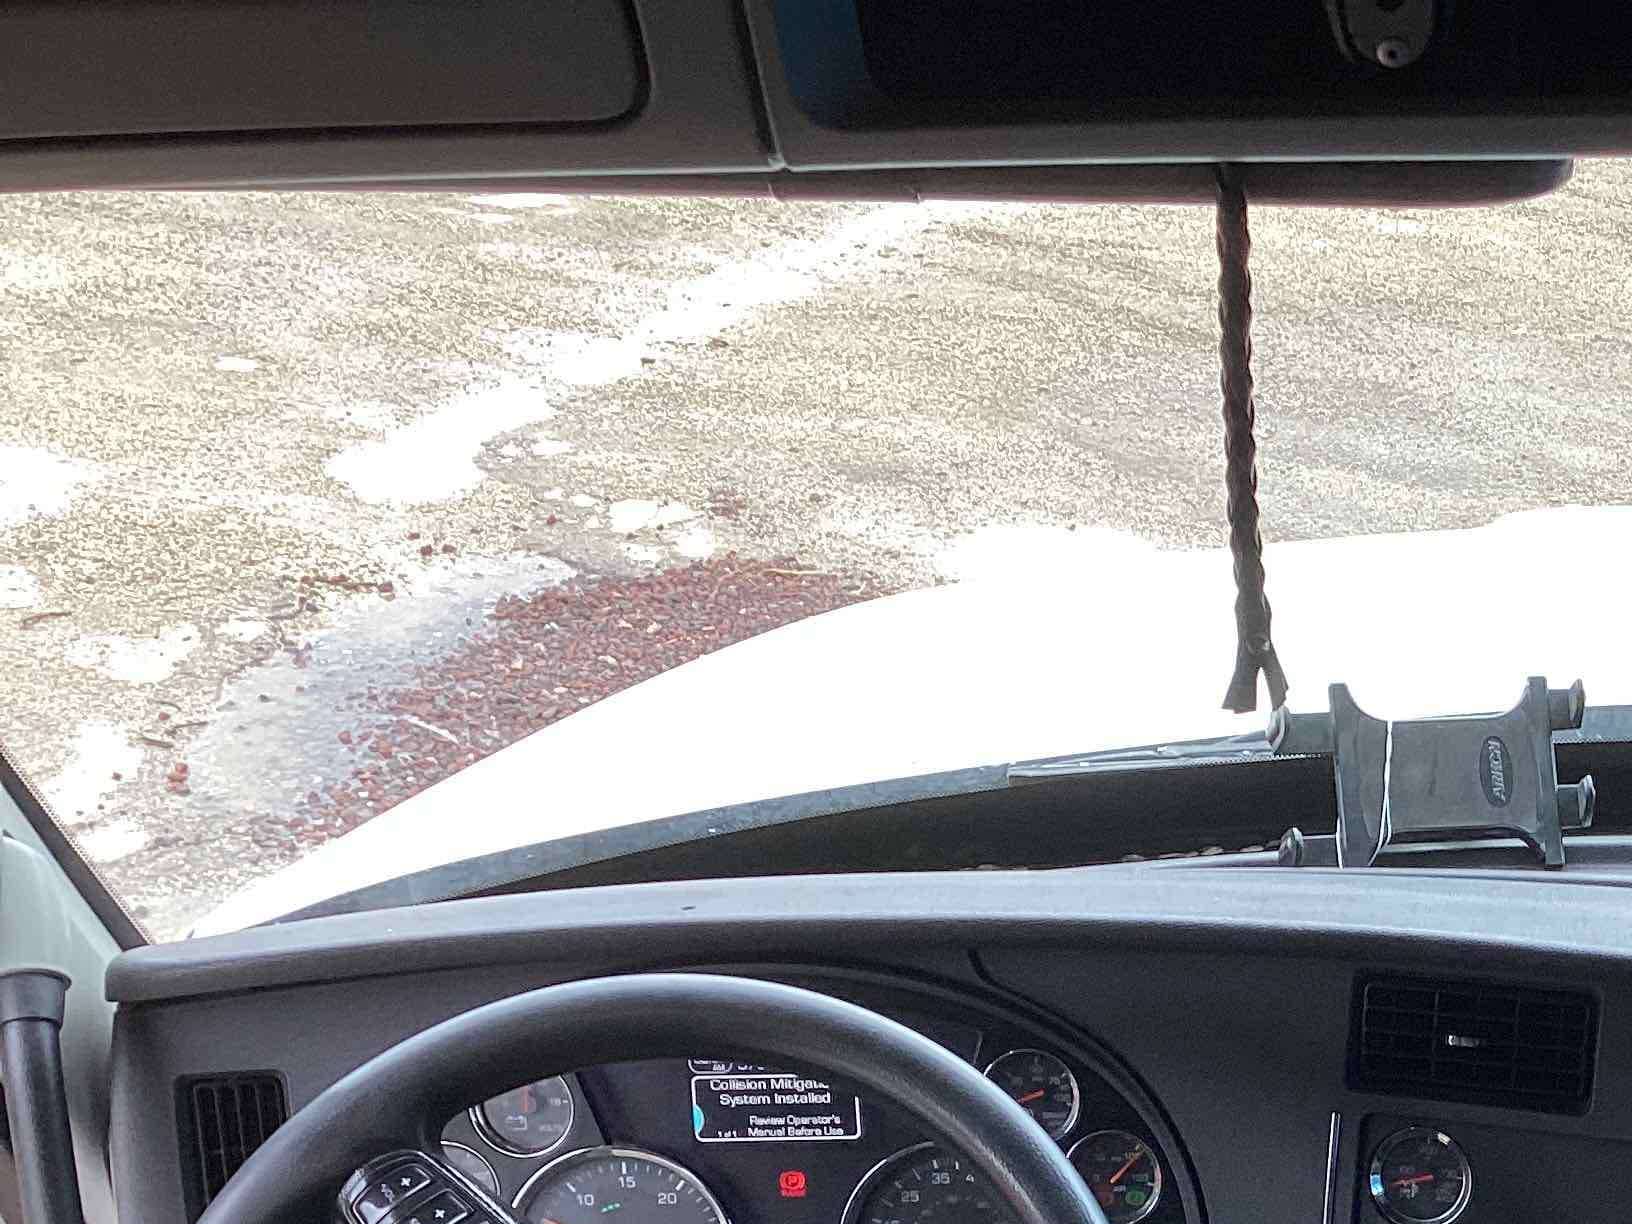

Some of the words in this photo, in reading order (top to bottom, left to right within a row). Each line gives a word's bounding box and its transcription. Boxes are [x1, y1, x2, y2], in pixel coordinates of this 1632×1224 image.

[710, 1079, 767, 1090] Collision
[719, 1093, 771, 1107] System
[774, 1092, 831, 1104] Installed
[749, 1116, 785, 1124] Review
[786, 1115, 841, 1126] Operator's
[747, 1127, 785, 1137] Manual
[787, 1126, 822, 1136] Before
[823, 1126, 844, 1136] Use
[618, 1177, 636, 1188] 15
[931, 1172, 950, 1184] 35
[577, 1194, 594, 1206] 10
[658, 1193, 677, 1205] 20
[901, 1190, 920, 1202] 25
